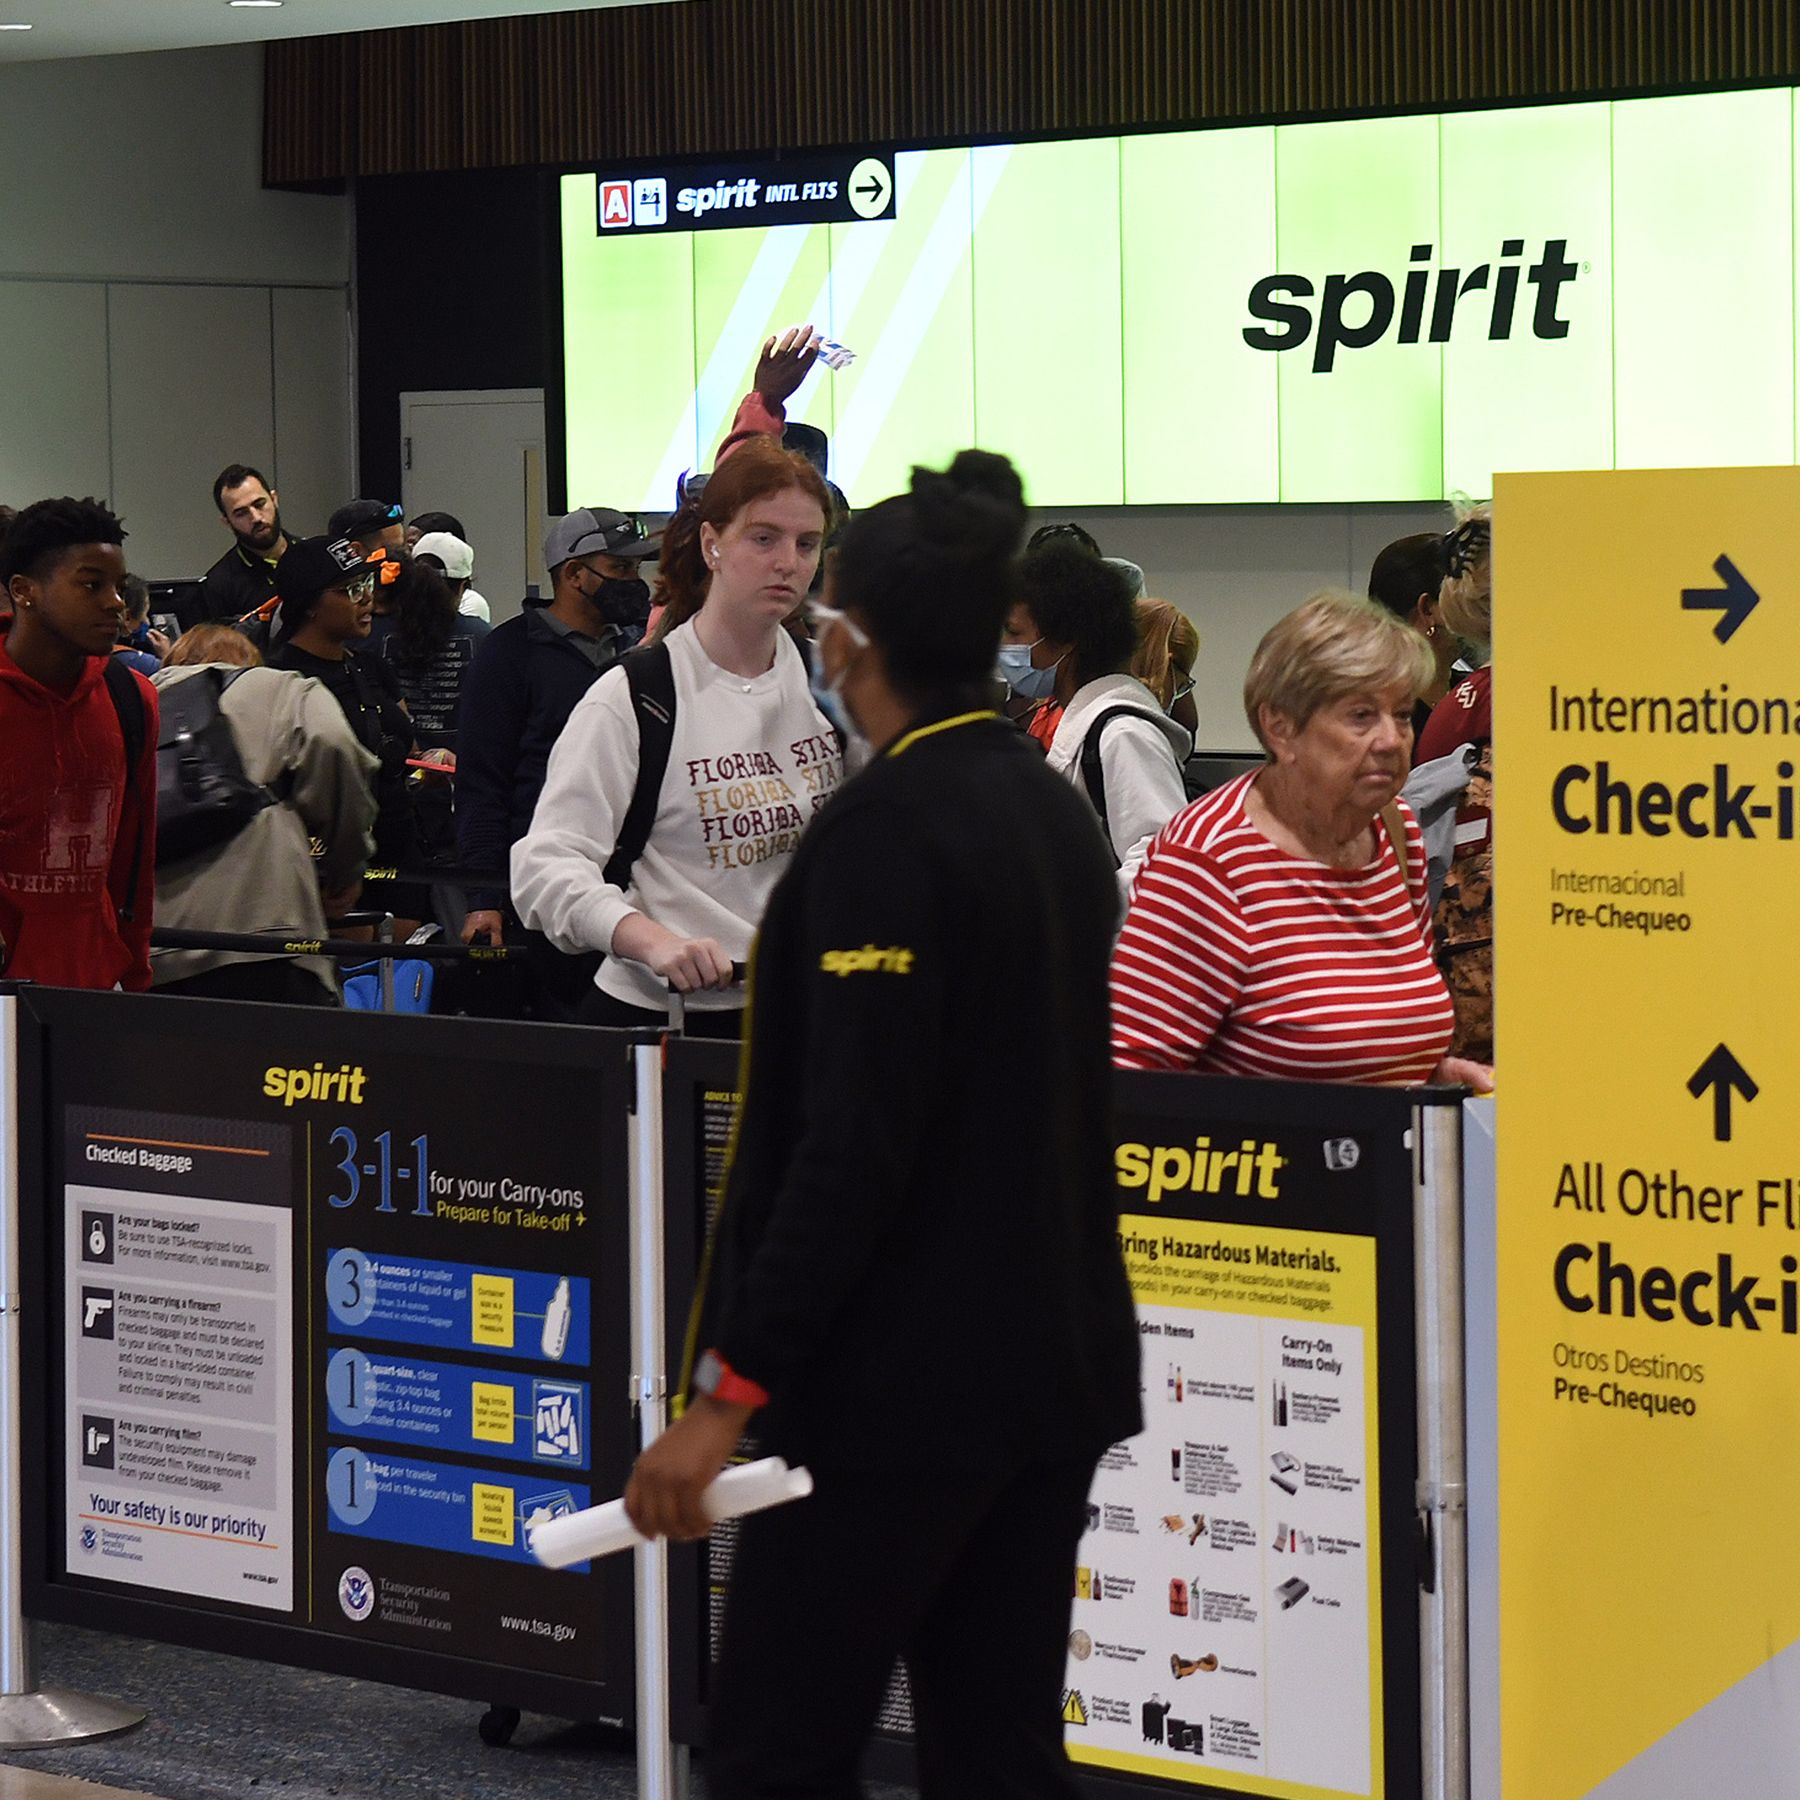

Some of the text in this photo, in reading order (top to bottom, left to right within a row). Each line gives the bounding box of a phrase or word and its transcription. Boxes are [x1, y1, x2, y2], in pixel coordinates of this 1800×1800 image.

[605, 189, 628, 220] A
[676, 178, 838, 217] spirit INTL FLTS
[1242, 239, 1579, 373] spirit
[686, 752, 783, 786] FLORIDA
[697, 777, 796, 817] FLORIDA
[701, 803, 804, 843] FLORIDA
[363, 867, 399, 880] spirit
[1551, 868, 1685, 897] Internacional
[1551, 902, 1692, 936] Pre-Chequeo
[263, 1062, 367, 1106] spirit
[85, 1144, 193, 1173] Checked Baggage
[328, 1126, 433, 1217] 3-1-1
[1114, 1136, 1282, 1202] spirit
[429, 1170, 584, 1210] for your Carry-ons
[1553, 1161, 1605, 1213] All
[1618, 1168, 1743, 1224] Other
[118, 1214, 200, 1232] Are your bags locked?
[437, 1201, 571, 1232] Prepare for Take-off
[1162, 1236, 1250, 1264] Hazardous
[1256, 1245, 1341, 1273] Materials.
[342, 1259, 360, 1309] 3
[380, 1265, 411, 1276] ounces
[412, 1268, 421, 1278] or
[1222, 1270, 1232, 1281] of
[118, 1291, 131, 1301] Are
[133, 1295, 147, 1305] you
[149, 1295, 180, 1309] carrying
[1171, 1284, 1192, 1297] your
[1237, 1290, 1247, 1300] or
[1164, 1323, 1195, 1339] Items
[1282, 1335, 1333, 1354] Carry-On
[1282, 1353, 1343, 1376] Items Only
[1553, 1342, 1704, 1384] Otros Destinos
[346, 1360, 358, 1409] 1
[1555, 1377, 1696, 1418] Pre-Chequeo
[119, 1420, 131, 1430] Are
[134, 1424, 148, 1435] you
[149, 1425, 180, 1439] carrying
[346, 1458, 358, 1509] 1
[372, 1462, 389, 1477] bag
[390, 1467, 405, 1478] per
[403, 1484, 417, 1496] the
[419, 1488, 450, 1504] security
[90, 1493, 266, 1542] Your safety is our priority
[380, 1577, 450, 1601] Transportation
[380, 1593, 420, 1615] Security
[380, 1608, 451, 1632] Administration
[501, 1614, 577, 1640] www.tsa.gov
